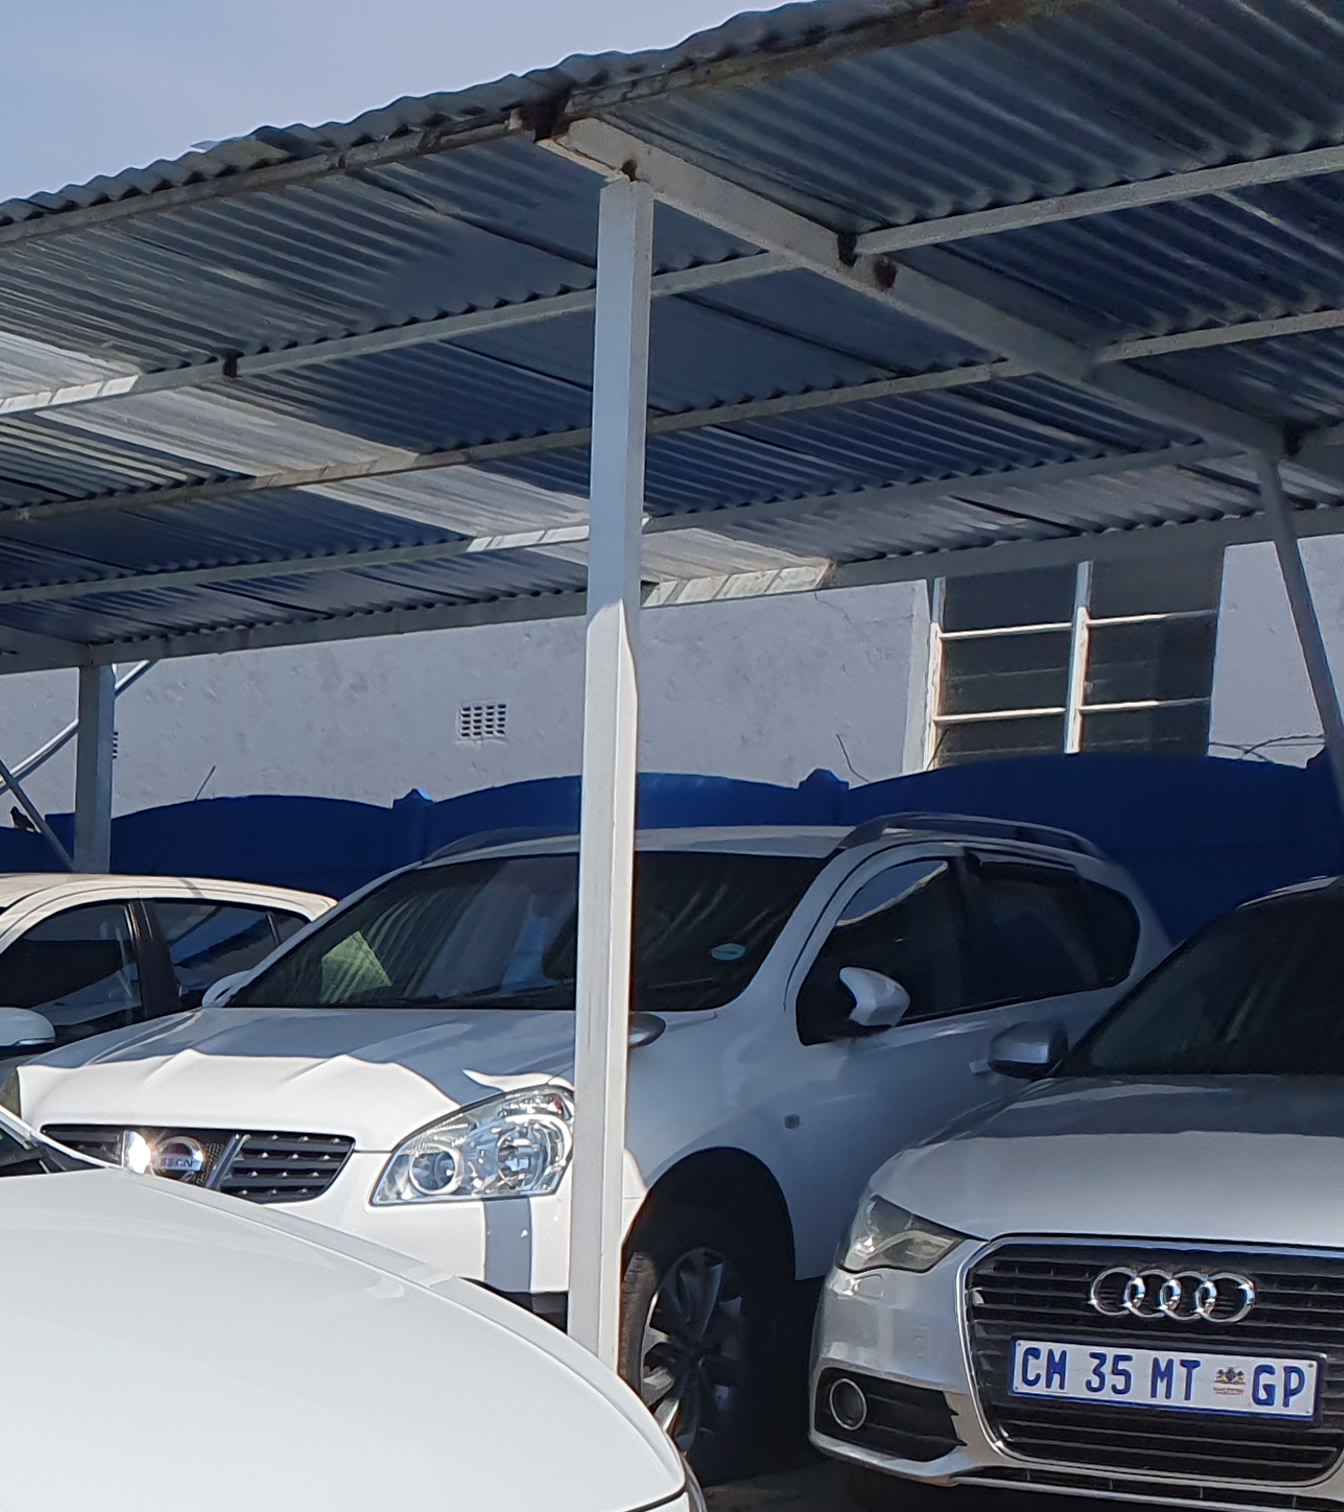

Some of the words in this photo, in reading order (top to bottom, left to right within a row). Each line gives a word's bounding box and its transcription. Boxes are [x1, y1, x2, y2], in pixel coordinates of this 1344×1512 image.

[1021, 1347, 1068, 1391] CM
[1085, 1352, 1134, 1396] 35
[1150, 1356, 1202, 1401] MT
[1251, 1364, 1307, 1408] GP
